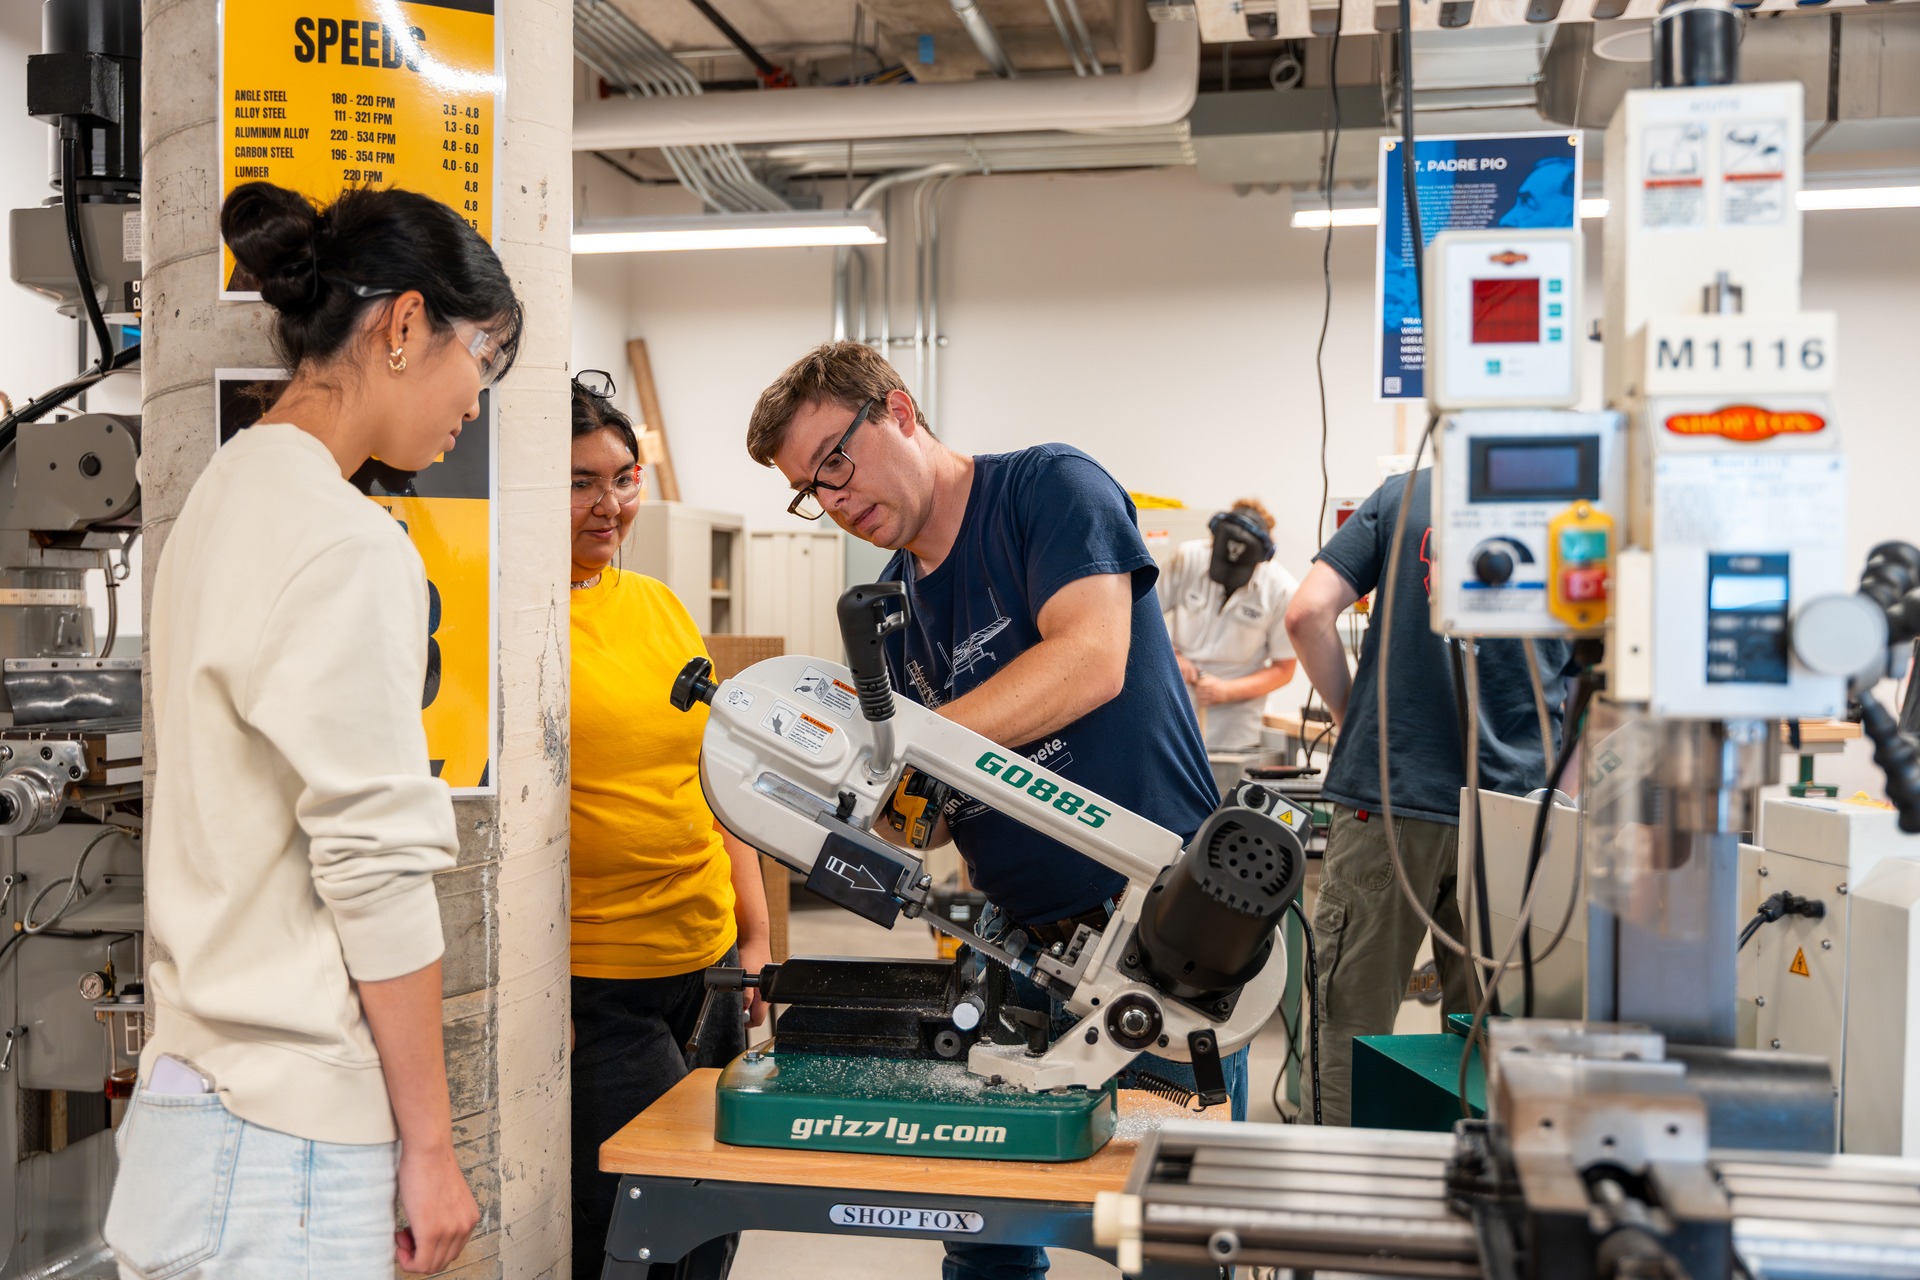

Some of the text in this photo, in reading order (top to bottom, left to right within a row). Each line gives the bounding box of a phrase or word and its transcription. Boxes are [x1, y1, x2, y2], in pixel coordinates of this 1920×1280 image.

[294, 16, 427, 73] SPEEDS
[234, 89, 288, 102] ANGLE STEEL
[331, 92, 348, 105] 180
[356, 94, 374, 107] 220
[376, 95, 396, 109] FPM
[234, 106, 287, 119] ALLOY STEEL
[334, 109, 346, 122] 111
[355, 111, 371, 124] 321
[373, 112, 393, 126] FPM
[443, 103, 457, 116] 3.5
[465, 106, 480, 119] 4.8
[234, 126, 310, 140] ALUMINUM ALLOY
[444, 120, 457, 133] 1.3
[465, 123, 479, 136] 6.0
[330, 129, 348, 142] 220
[356, 130, 375, 143] 534
[377, 132, 396, 145] FPM
[234, 146, 295, 159] CARBON STEEL
[442, 139, 457, 152] 4.8
[464, 142, 479, 155] 6.0
[331, 148, 347, 161] 196
[355, 150, 374, 163] 354
[376, 151, 395, 165] FPM
[1427, 158, 1479, 172] PADRE
[1480, 157, 1508, 171] PIO
[235, 166, 269, 178] LUMBER
[442, 158, 457, 171] 4.0
[464, 161, 479, 174] 6.0
[343, 169, 383, 183] 220 FPM
[464, 180, 479, 193] 4.8
[463, 199, 478, 212] 4.8
[1657, 337, 1825, 371] M1116
[790, 1114, 1007, 1144] grizzly.com
[843, 1206, 971, 1230] SHOP FOX
